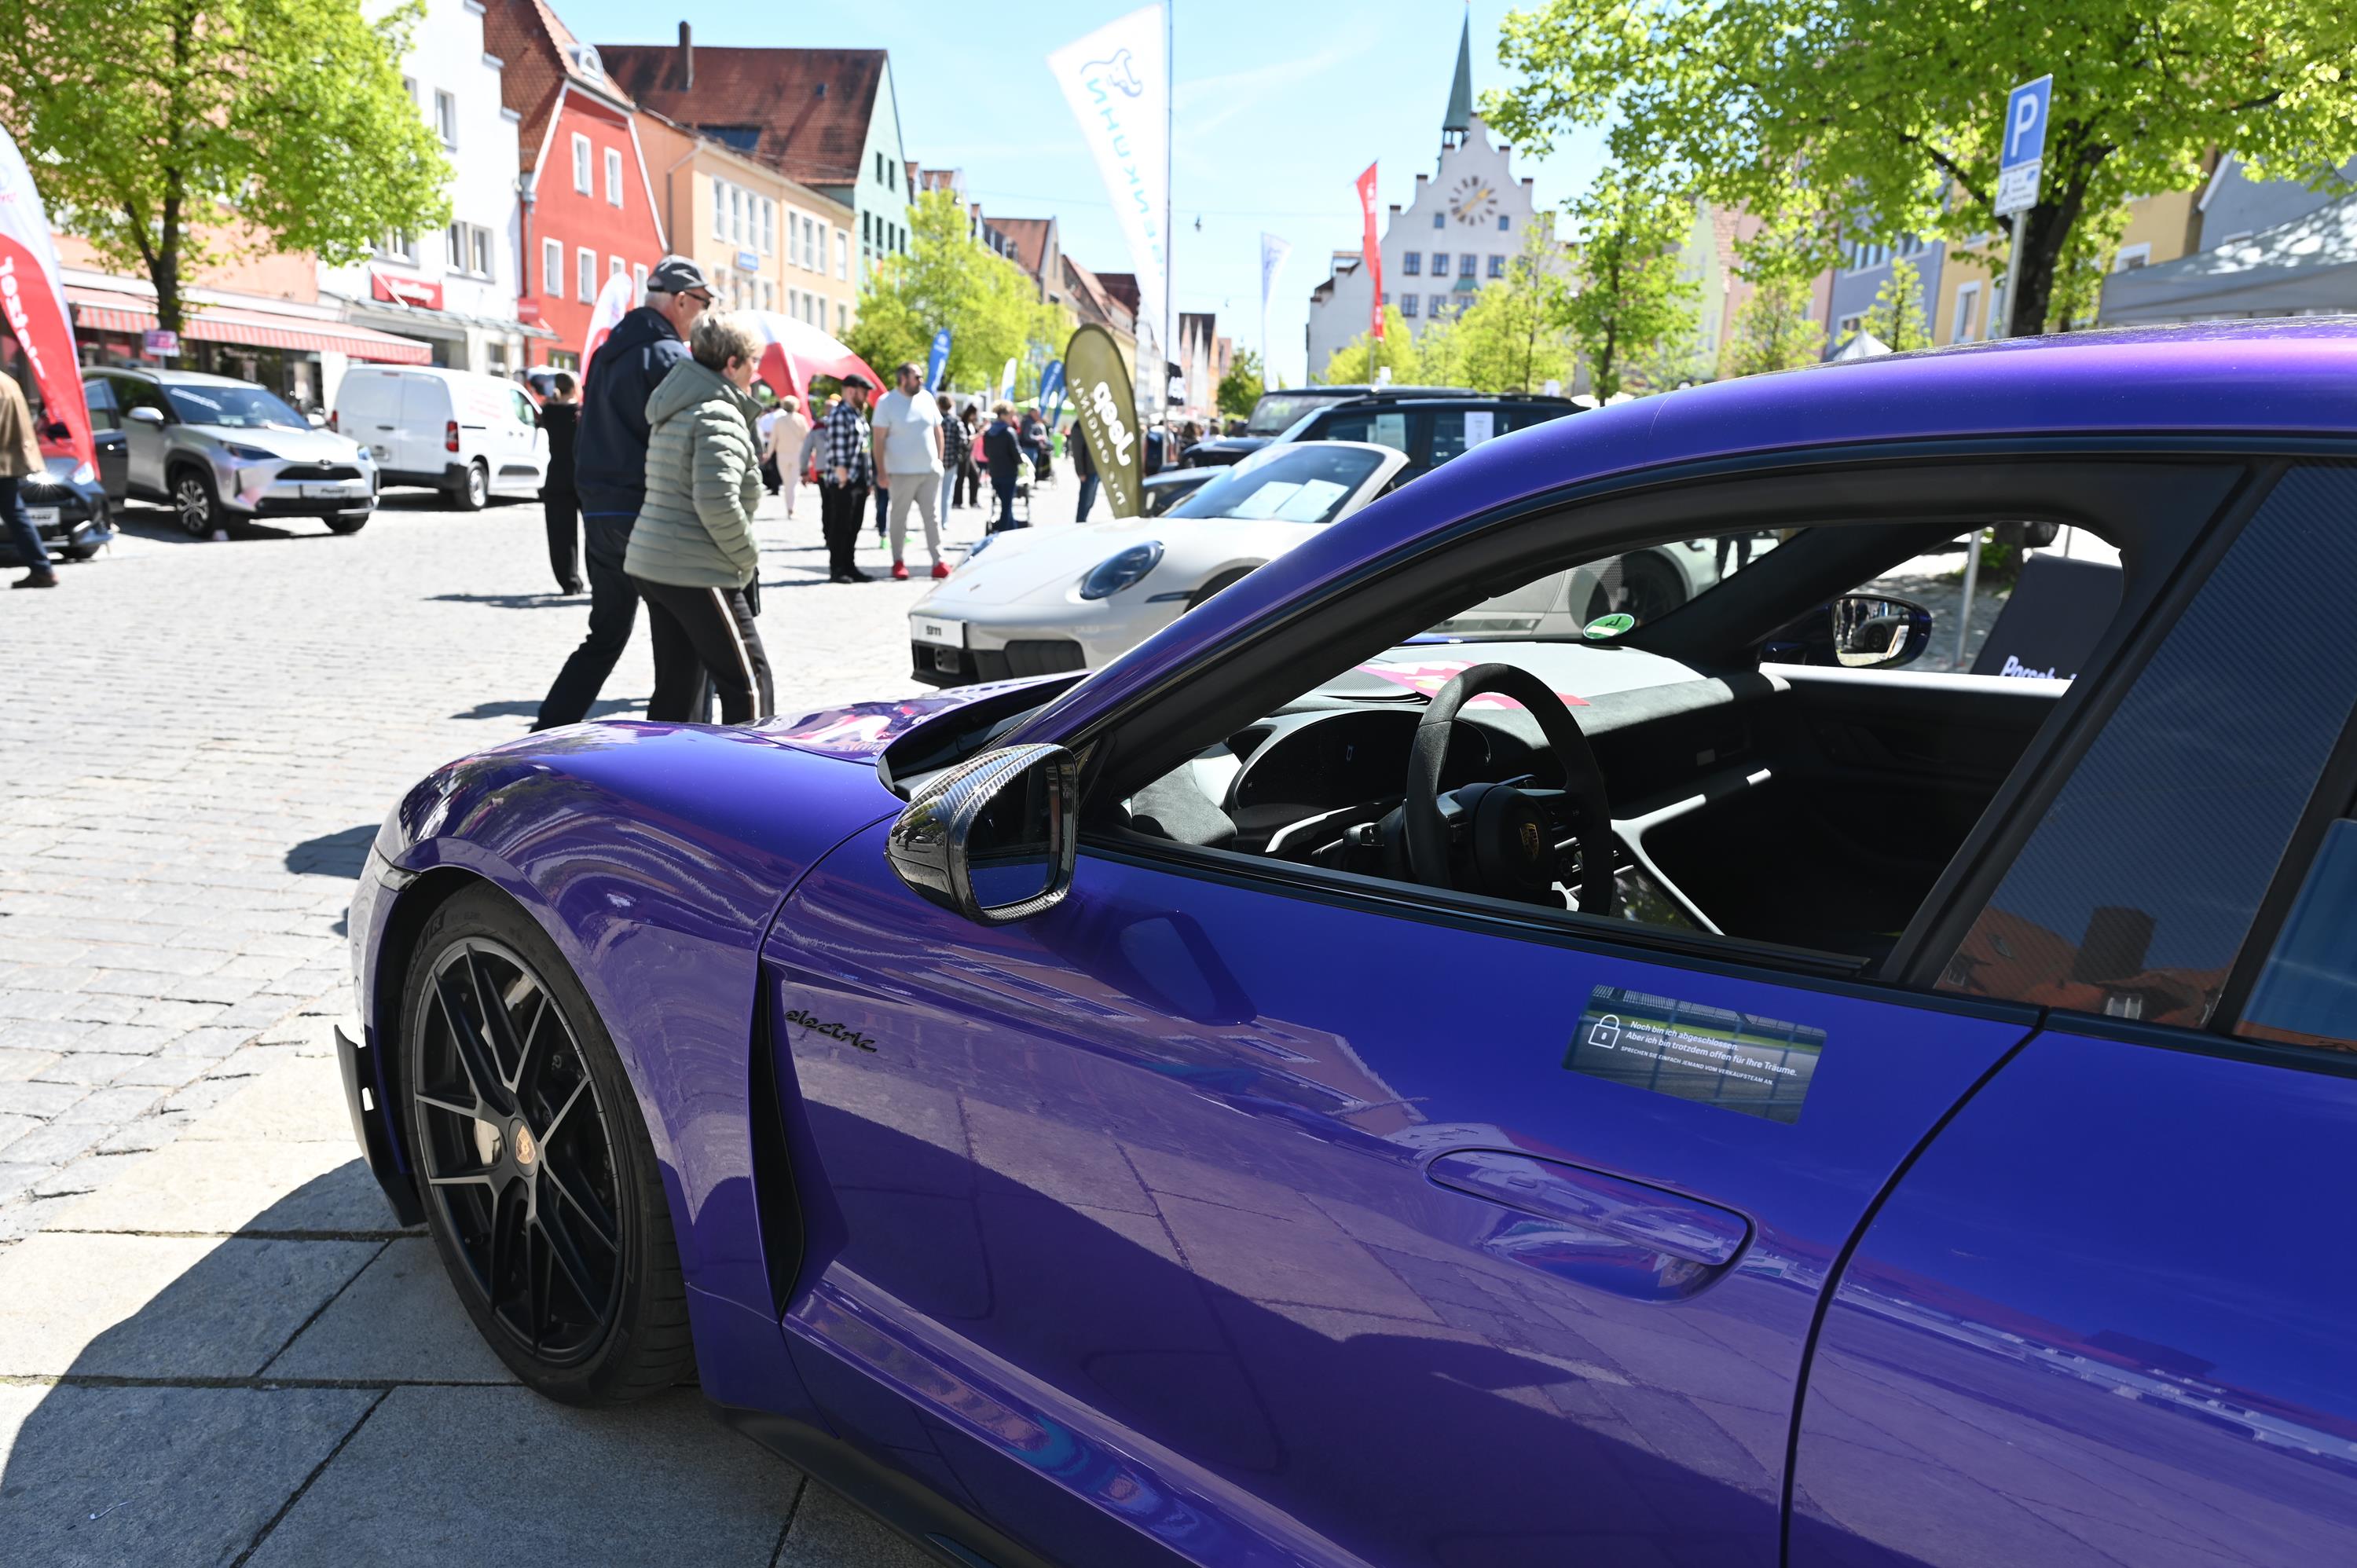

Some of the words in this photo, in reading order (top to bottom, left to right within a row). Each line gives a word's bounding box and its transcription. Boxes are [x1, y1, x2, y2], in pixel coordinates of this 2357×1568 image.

[2011, 93, 2039, 158] P
[926, 625, 941, 636] 911
[785, 1010, 878, 1053] electric
[1630, 1020, 1651, 1031] Noch
[1651, 1025, 1664, 1035] bin
[1665, 1028, 1677, 1037] ich
[1678, 1031, 1739, 1051] abgeschlossen.
[1621, 1046, 1648, 1057] SPRECHEN
[1658, 1053, 1682, 1064] EINFACH
[1681, 1060, 1705, 1069] JEMAND
[1705, 1064, 1718, 1073] VOM
[1718, 1068, 1764, 1083] VERKAUFSTEAM
[1626, 1031, 1644, 1042] Aber
[1645, 1035, 1657, 1045] ich
[1659, 1039, 1670, 1048] bin
[1672, 1042, 1708, 1057] trotzdem
[1709, 1050, 1731, 1061] offen
[1732, 1053, 1745, 1064] für
[1746, 1057, 1763, 1068] Ihre
[1765, 1061, 1798, 1076] Träume.
